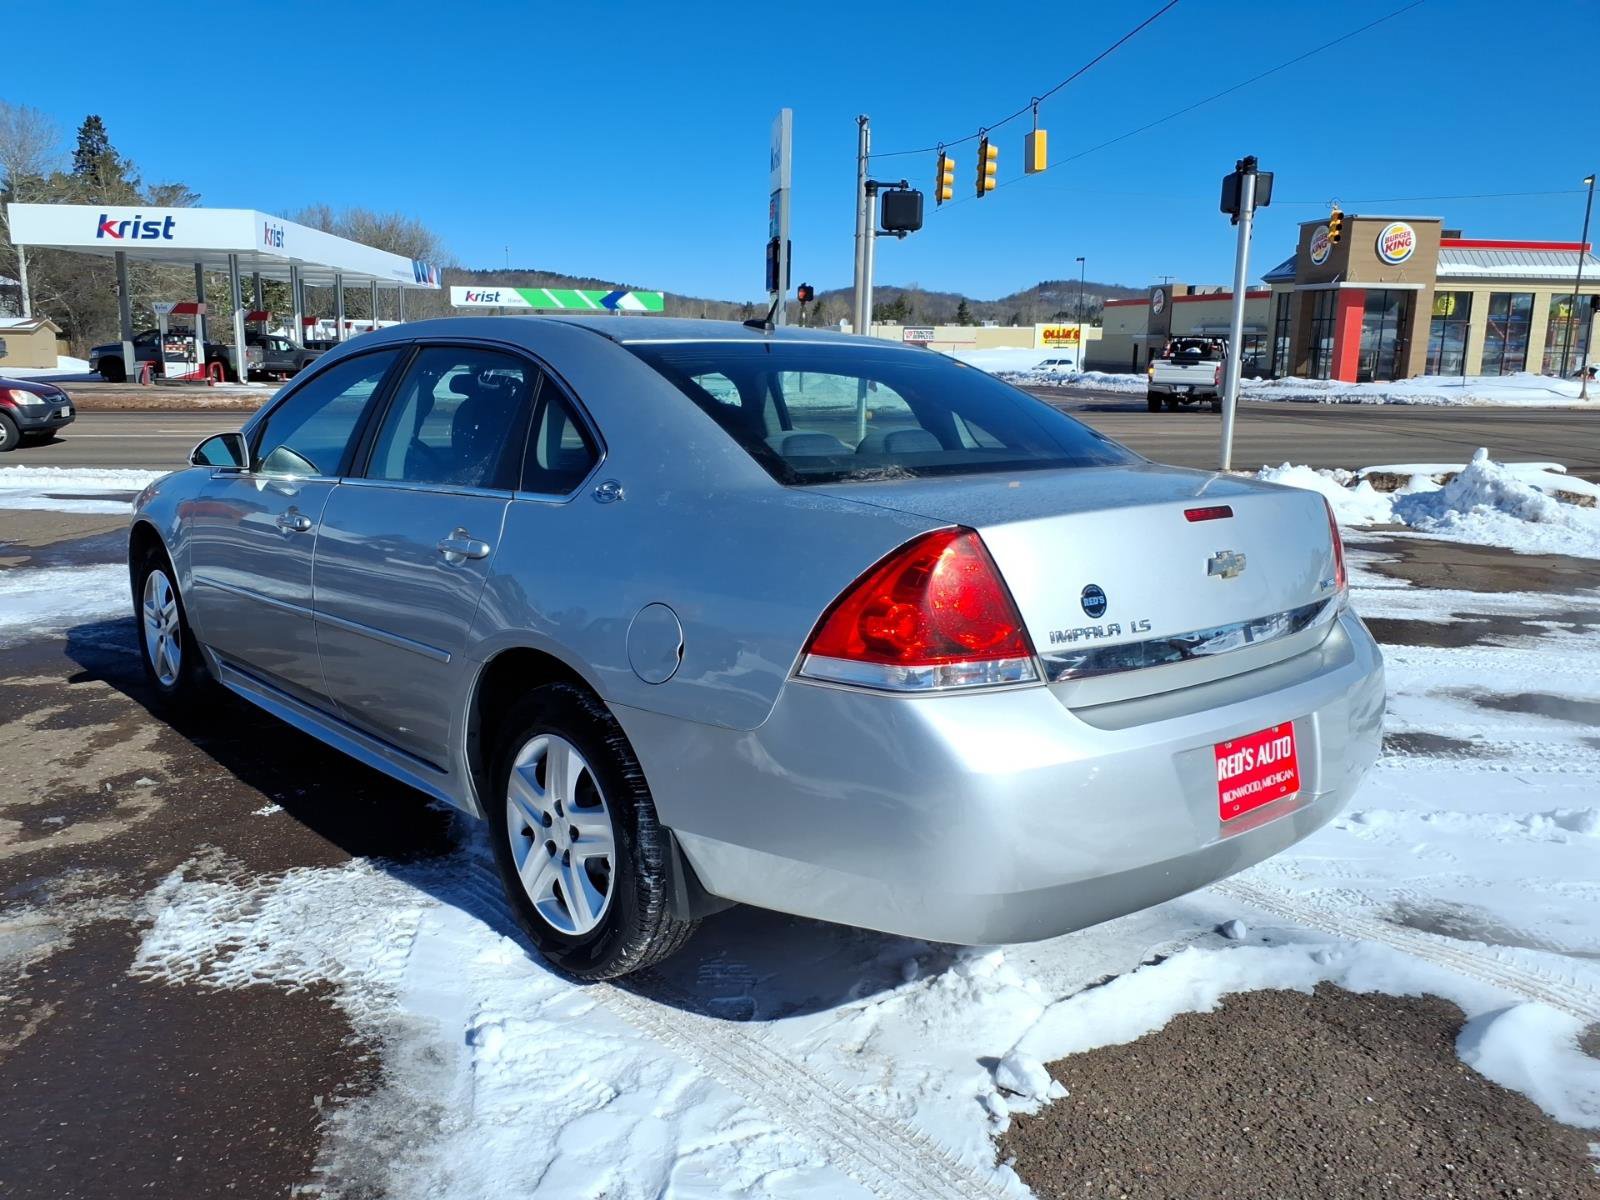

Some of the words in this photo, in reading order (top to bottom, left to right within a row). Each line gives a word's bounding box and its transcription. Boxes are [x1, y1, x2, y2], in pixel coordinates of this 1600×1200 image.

[96, 214, 176, 239] krist
[264, 222, 284, 248] krist
[1385, 231, 1411, 243] BURGER
[1384, 238, 1412, 253] KING
[465, 291, 500, 302] krist
[1049, 623, 1121, 644] IMPALA
[1130, 619, 1152, 633] LS
[1217, 747, 1254, 782] RED'S
[1256, 736, 1292, 767] AUTO
[1262, 768, 1294, 789] MICHIGAN
